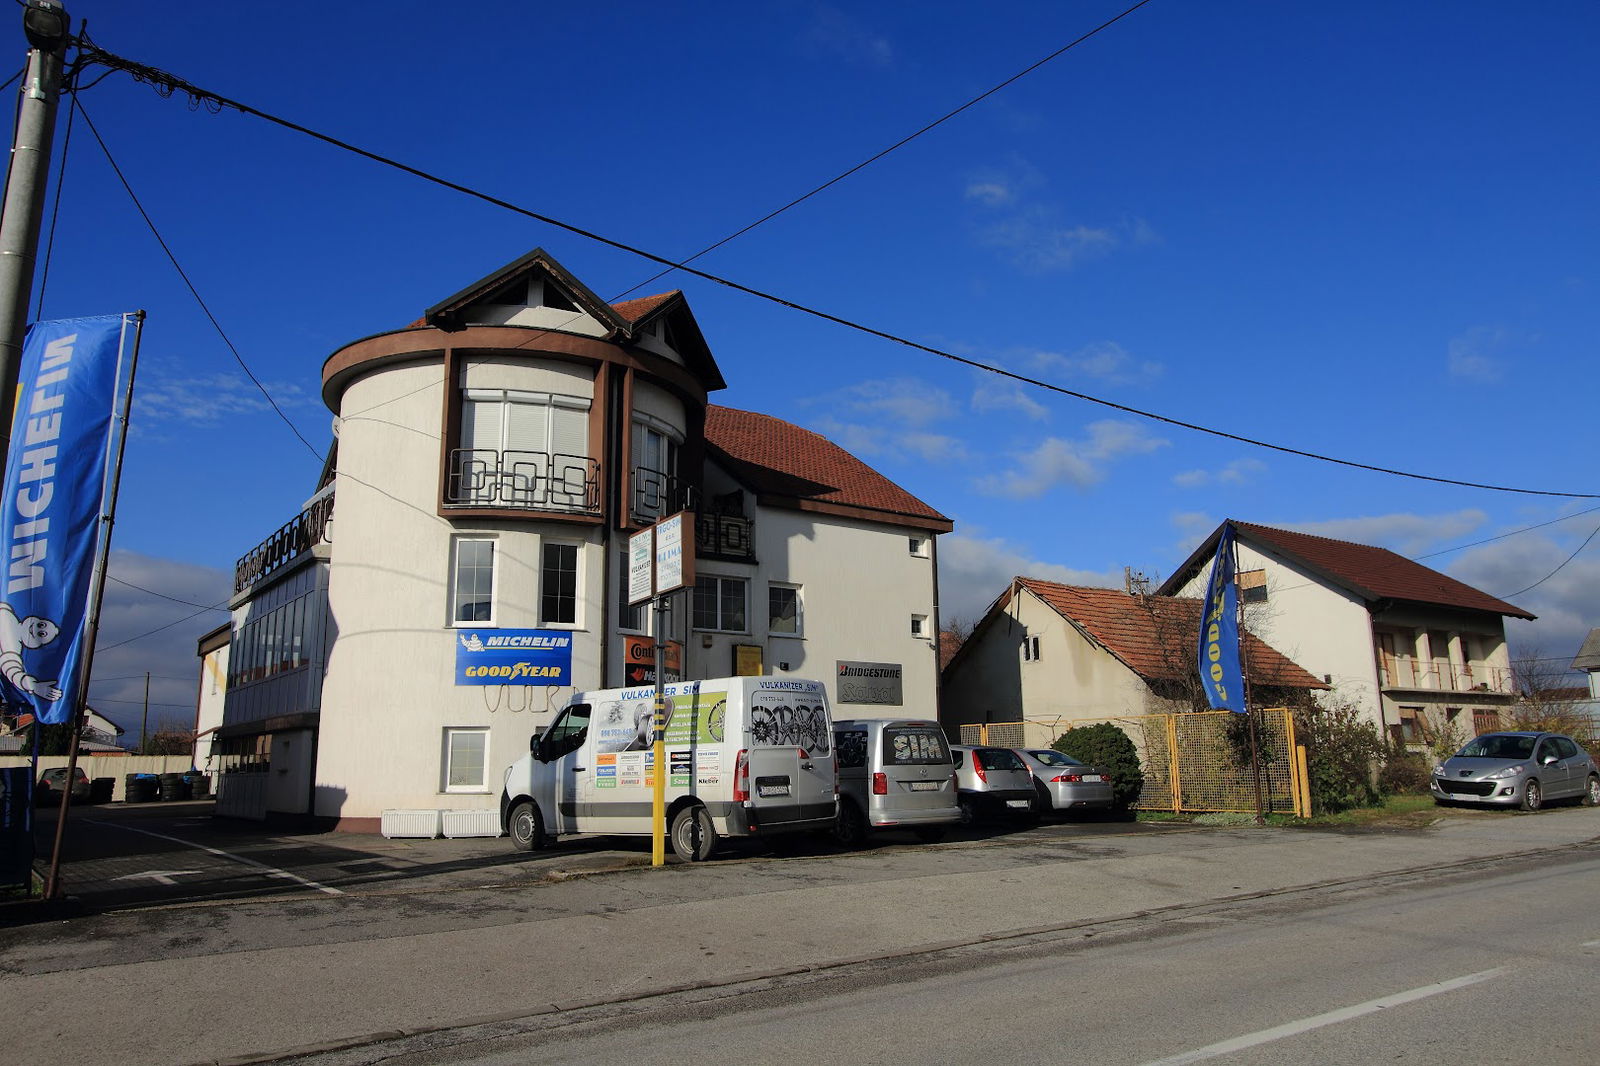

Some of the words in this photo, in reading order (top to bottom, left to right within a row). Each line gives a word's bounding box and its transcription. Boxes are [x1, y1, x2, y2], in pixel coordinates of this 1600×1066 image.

[486, 635, 570, 648] MICHELIN
[465, 663, 562, 679] GOODYEAR
[839, 665, 900, 679] BRIDGESTONE
[621, 687, 677, 701] VULKANER
[683, 683, 701, 695] SIM
[893, 734, 944, 760] SIM
